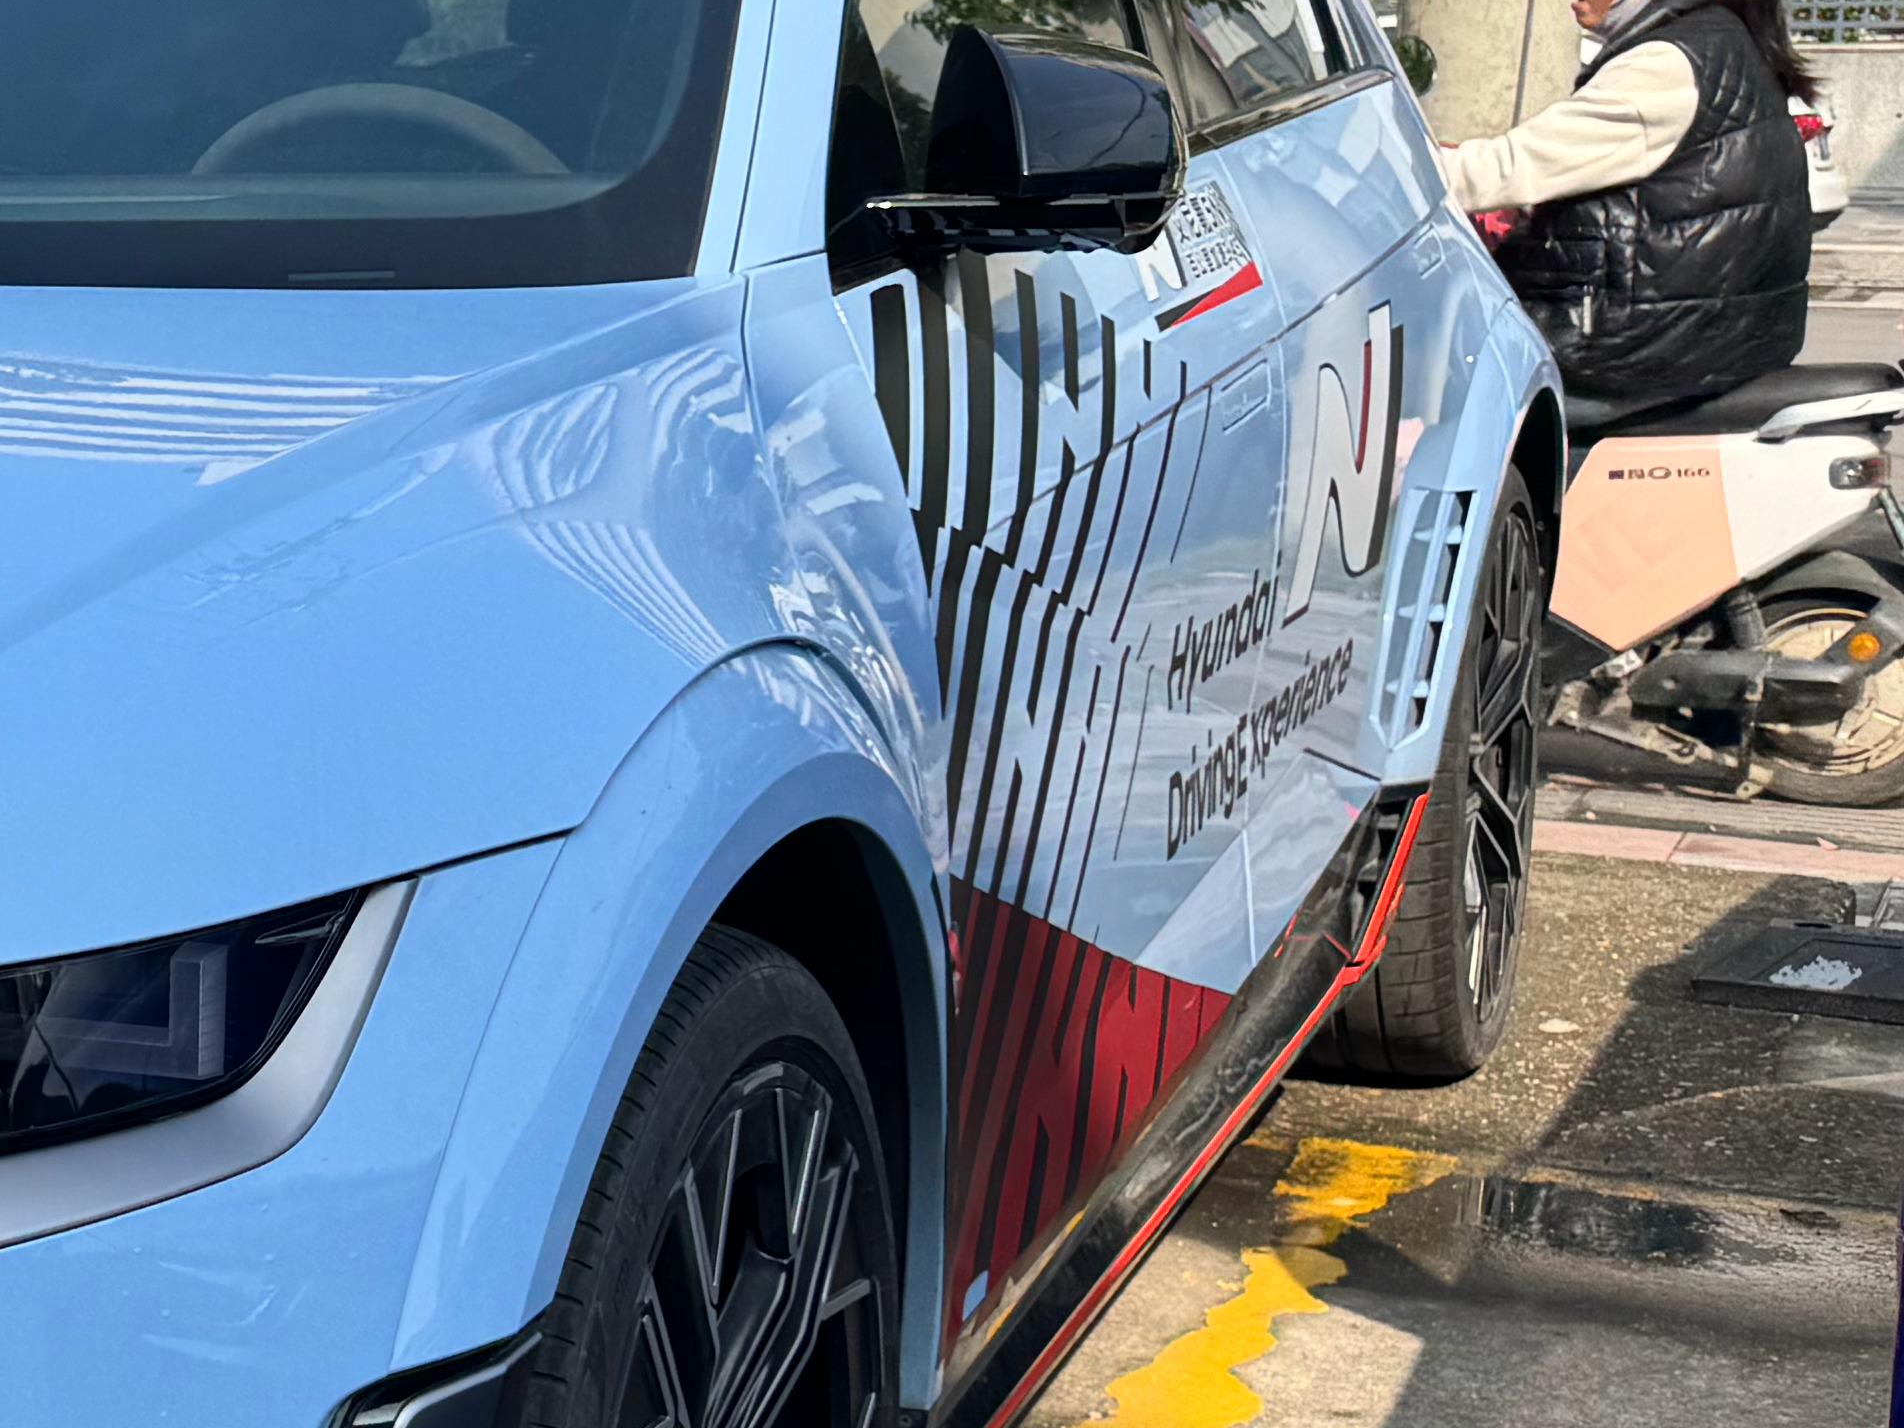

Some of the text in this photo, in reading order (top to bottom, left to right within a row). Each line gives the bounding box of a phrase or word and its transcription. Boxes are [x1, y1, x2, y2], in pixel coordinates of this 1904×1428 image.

[1281, 299, 1404, 629] N
[1166, 549, 1282, 715] Hyundai
[1166, 727, 1236, 862] Driving
